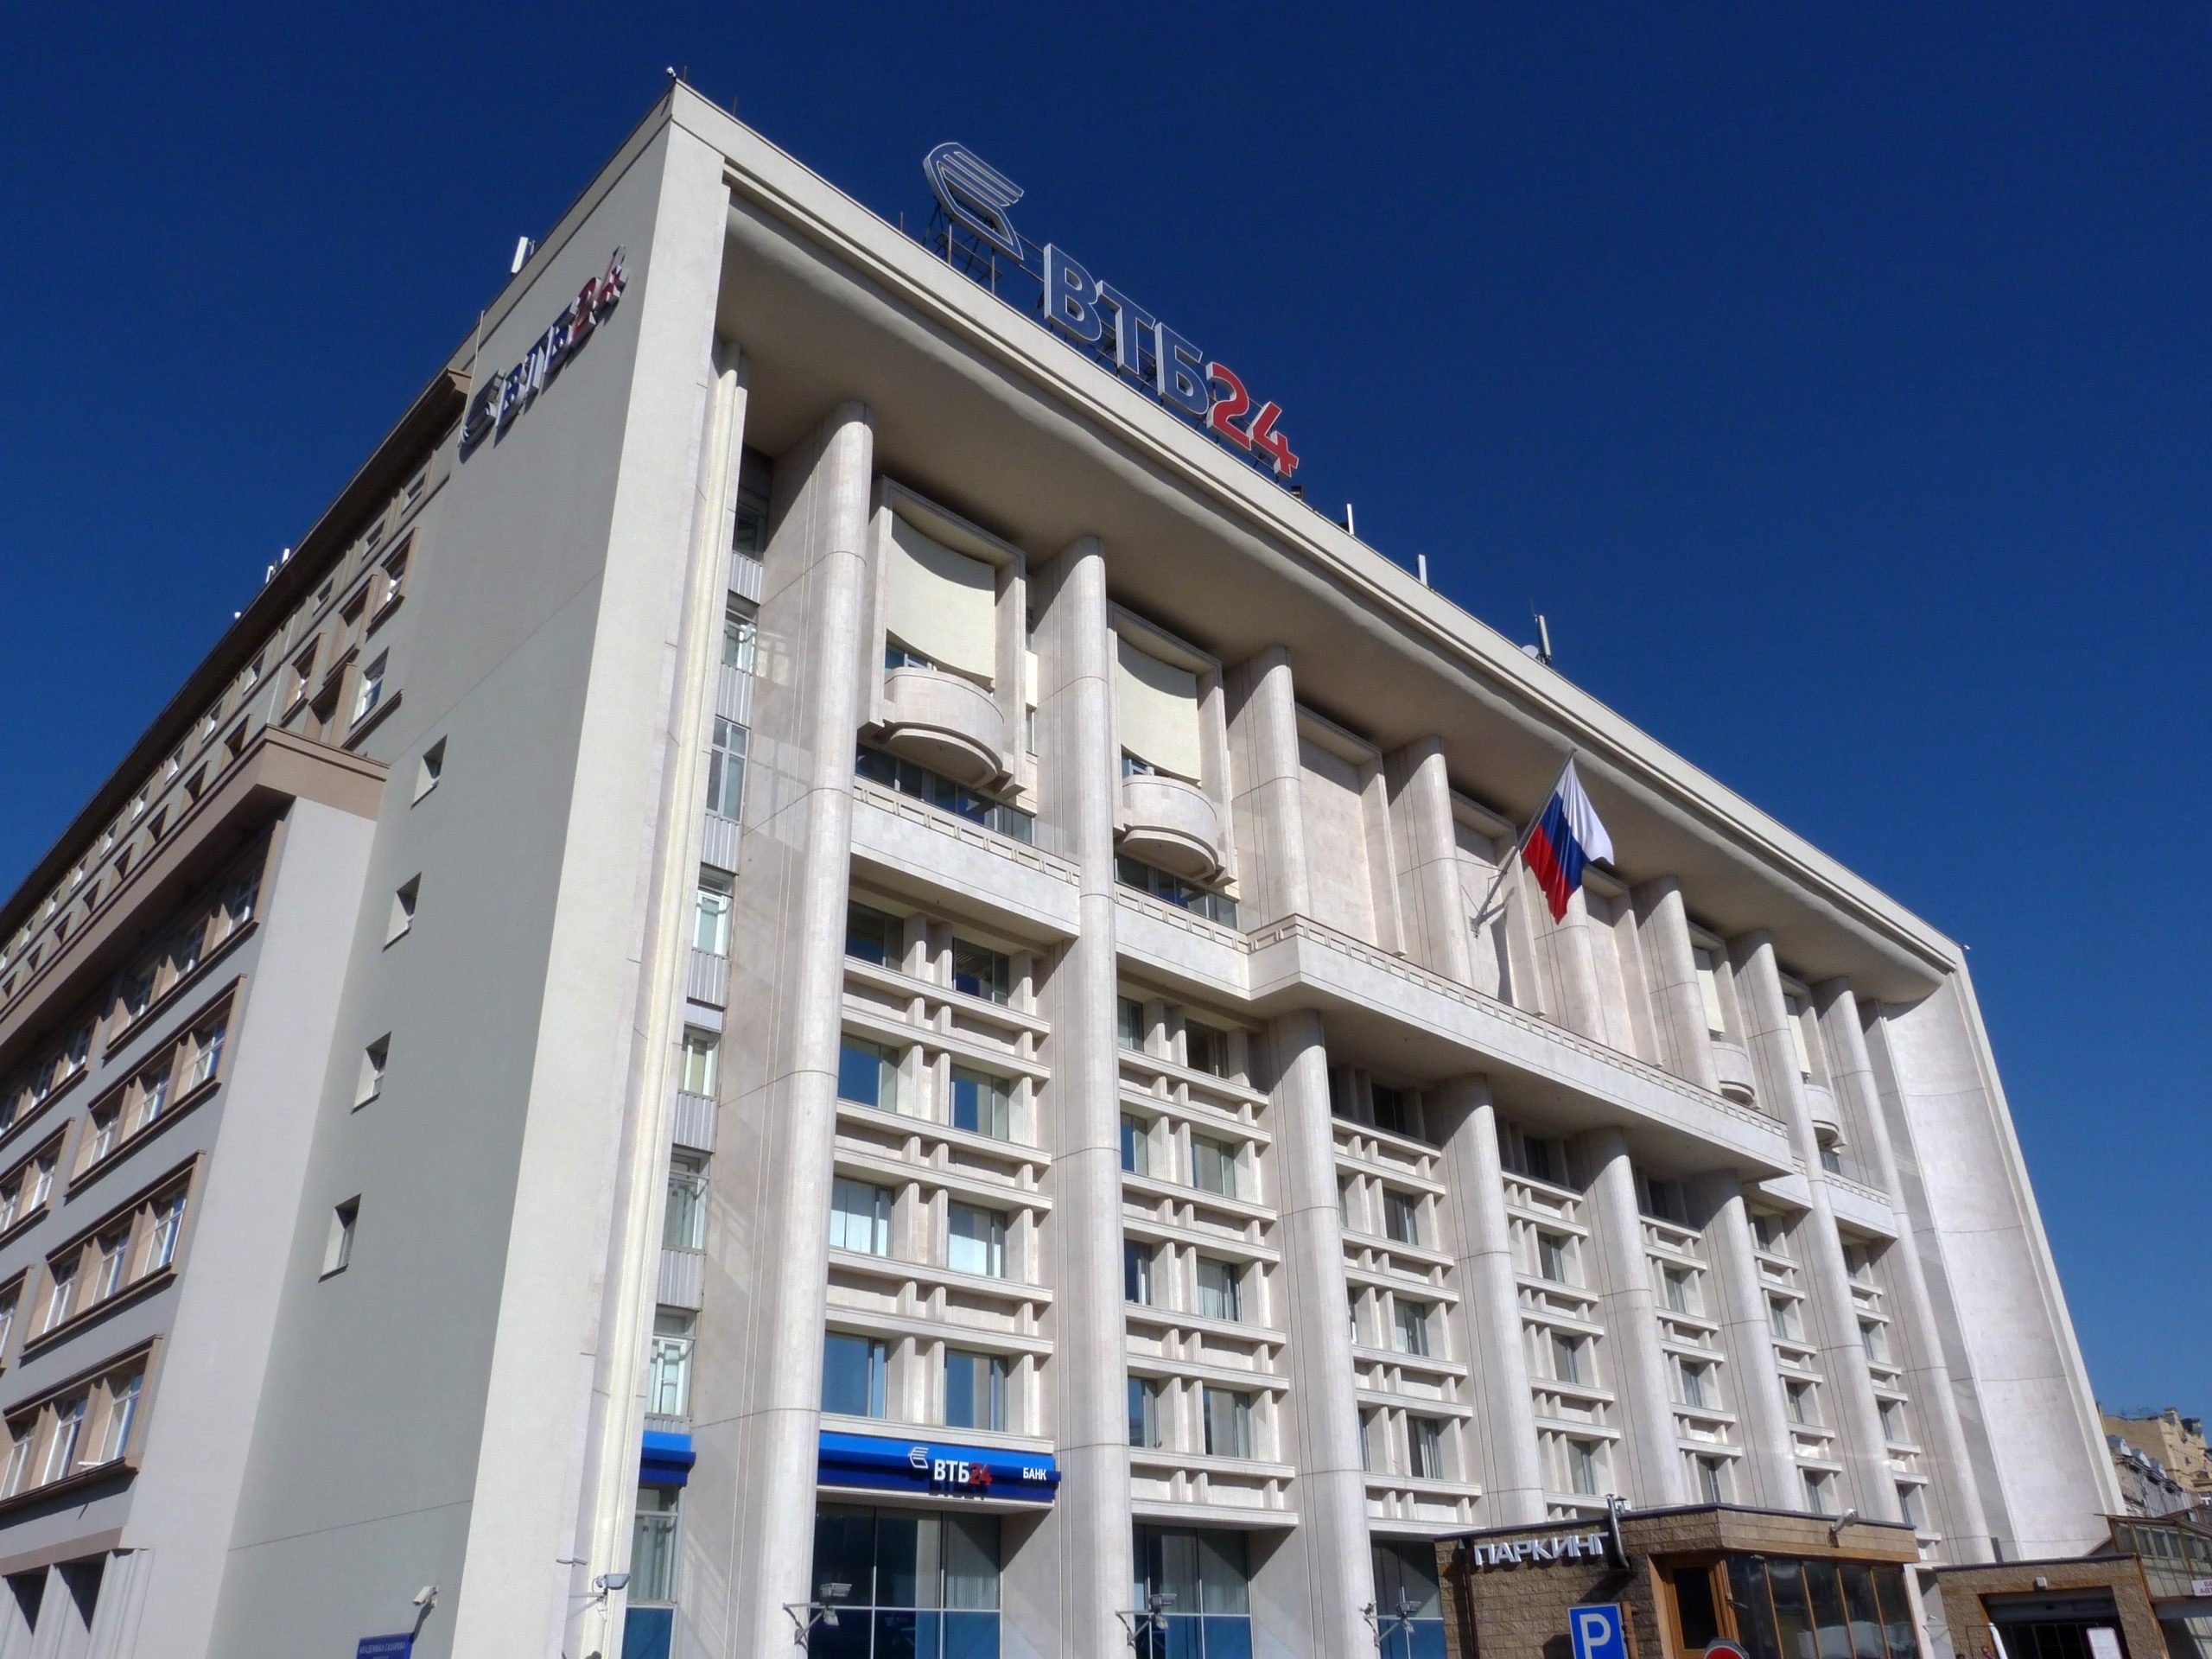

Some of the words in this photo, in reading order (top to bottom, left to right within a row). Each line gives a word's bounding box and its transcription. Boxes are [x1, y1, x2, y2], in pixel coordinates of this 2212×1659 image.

[1043, 243, 1299, 477] ВТБ24
[934, 1459, 993, 1484] ВТБ24
[1022, 1467, 1046, 1480] БАНК
[1474, 1532, 1609, 1566] ПАРКИНГ
